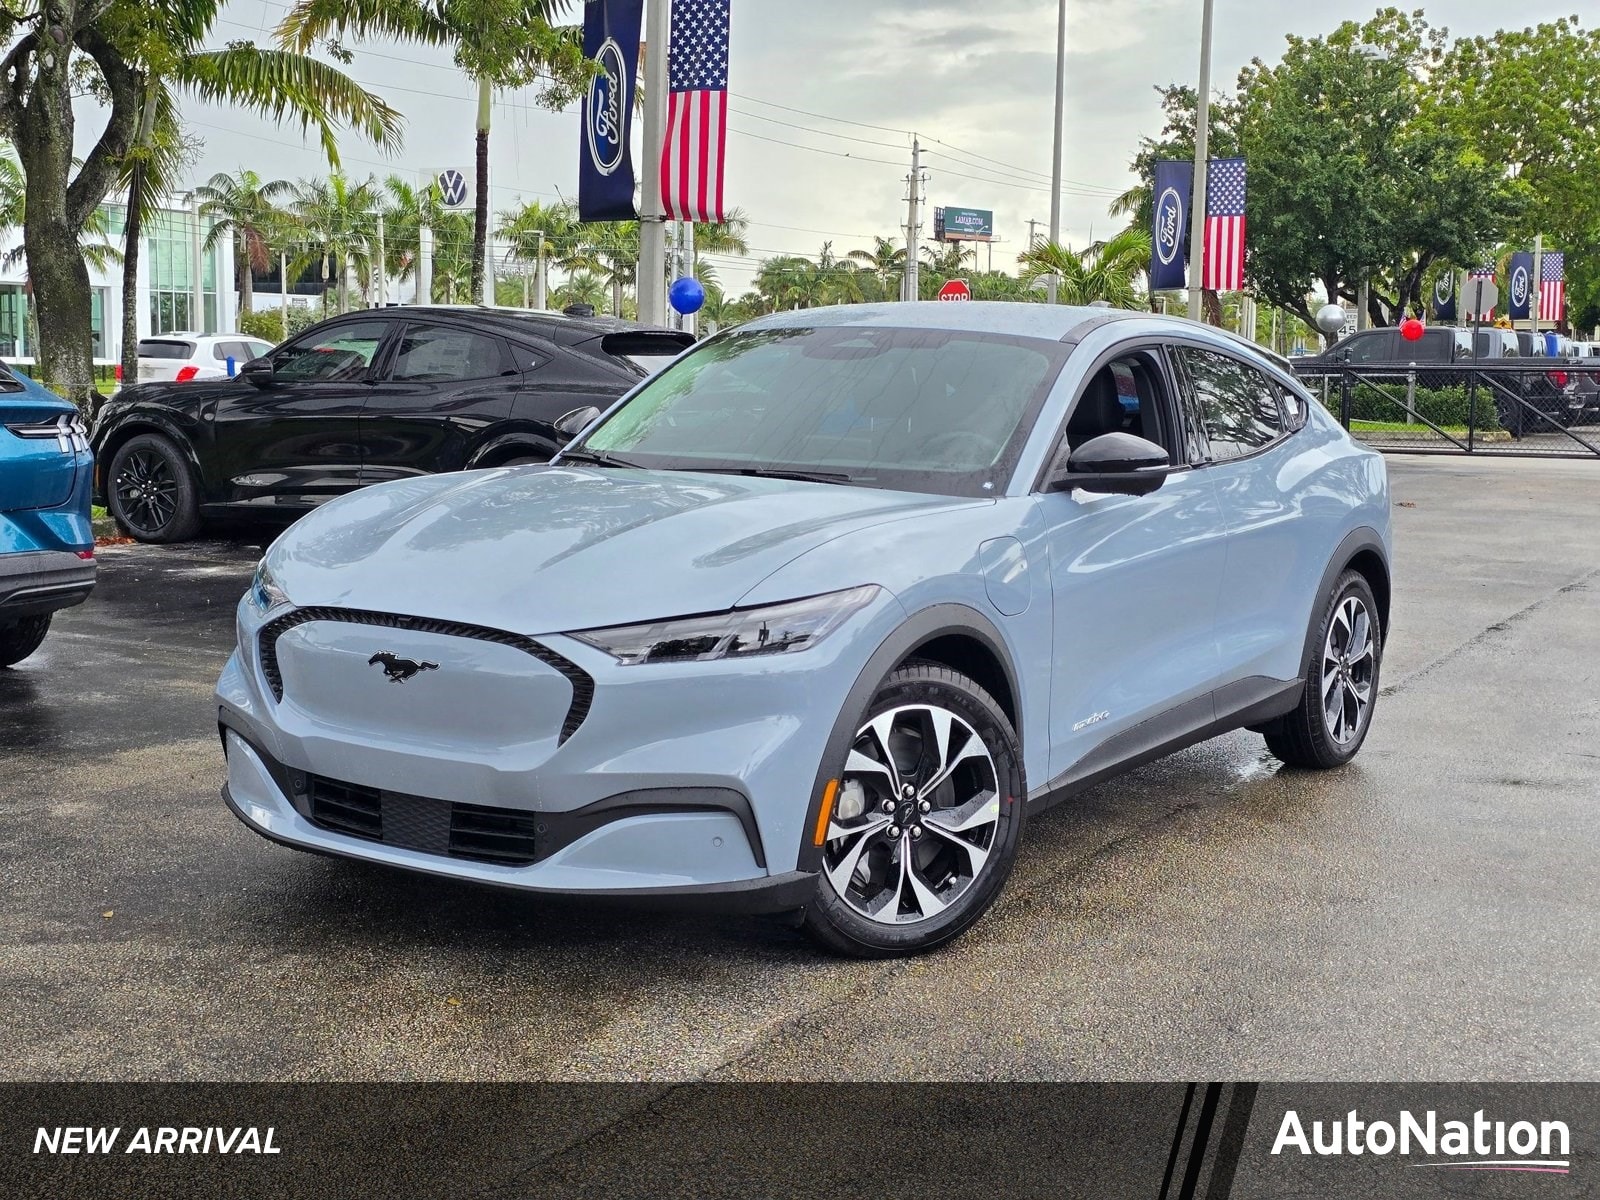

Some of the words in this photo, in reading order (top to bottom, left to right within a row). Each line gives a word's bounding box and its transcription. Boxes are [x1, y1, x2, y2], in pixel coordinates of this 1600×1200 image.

[596, 71, 618, 144] Ford
[1161, 205, 1176, 247] Ford
[941, 293, 968, 301] STOP
[1514, 275, 1525, 298] Ford
